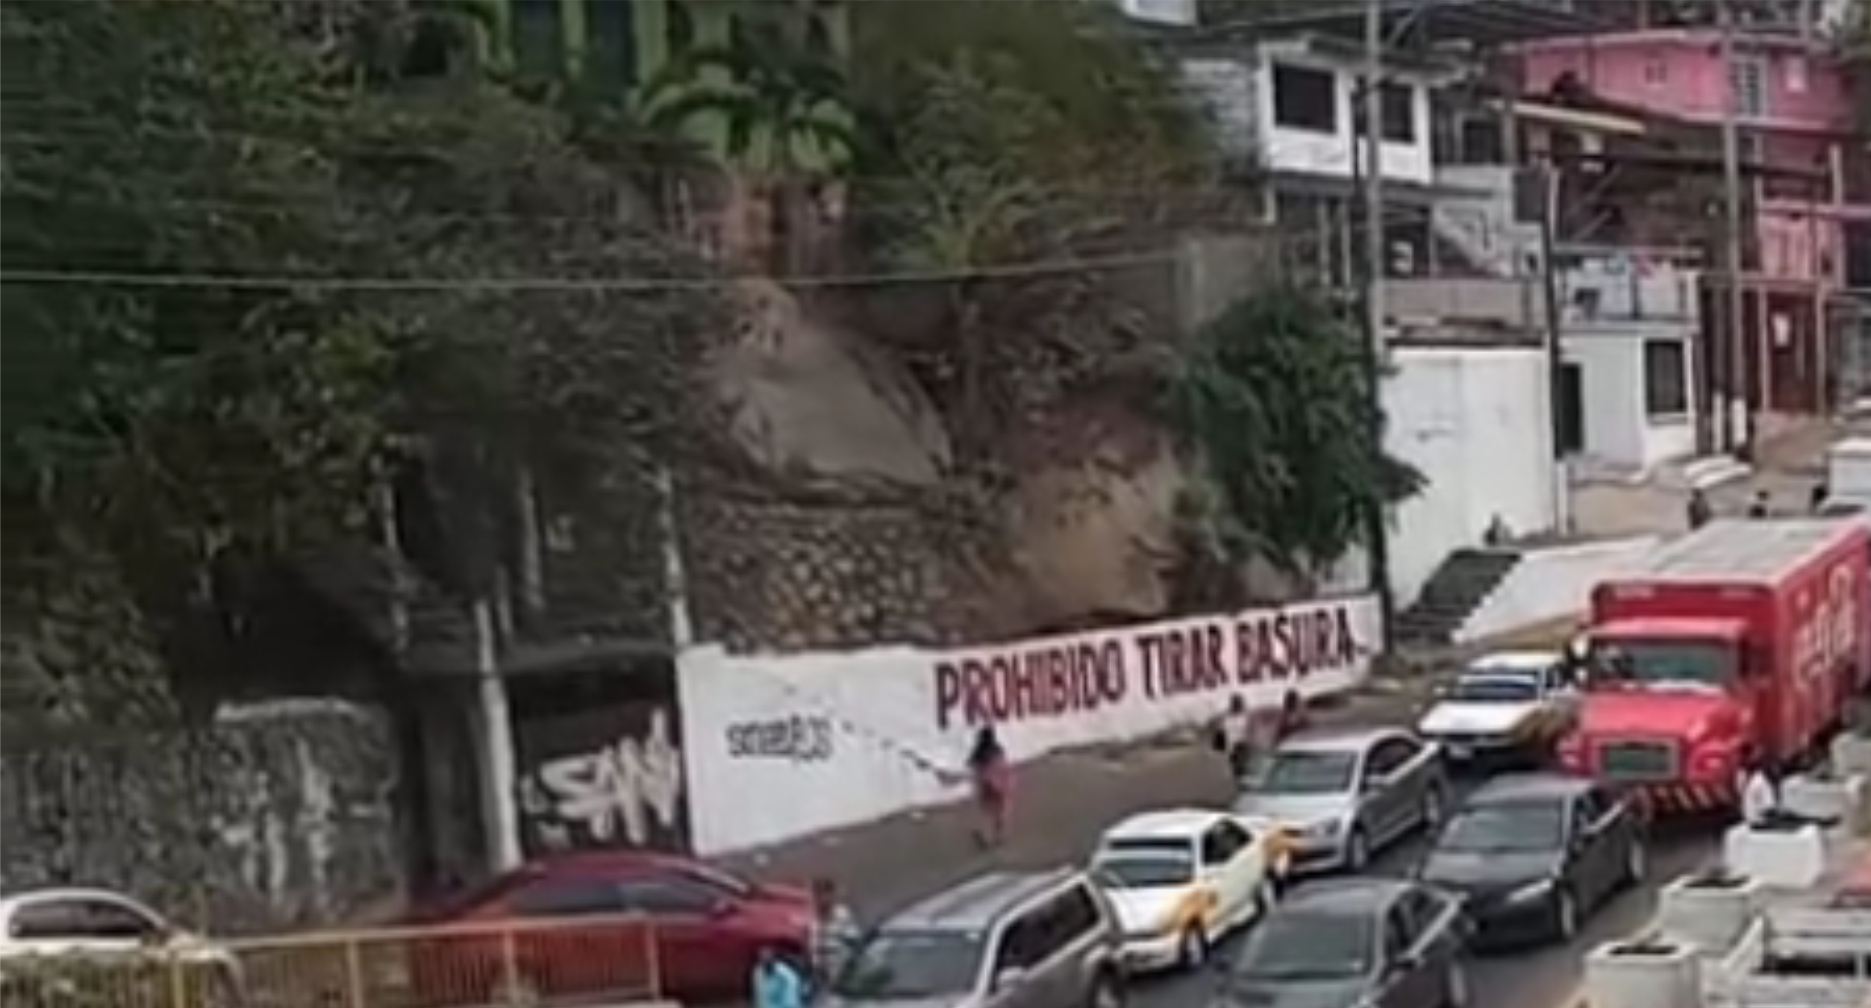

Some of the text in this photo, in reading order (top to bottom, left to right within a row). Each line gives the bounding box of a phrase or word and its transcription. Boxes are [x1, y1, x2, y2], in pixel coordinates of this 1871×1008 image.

[934, 606, 1357, 730] PROHIBIDO TIRAR BASURA
